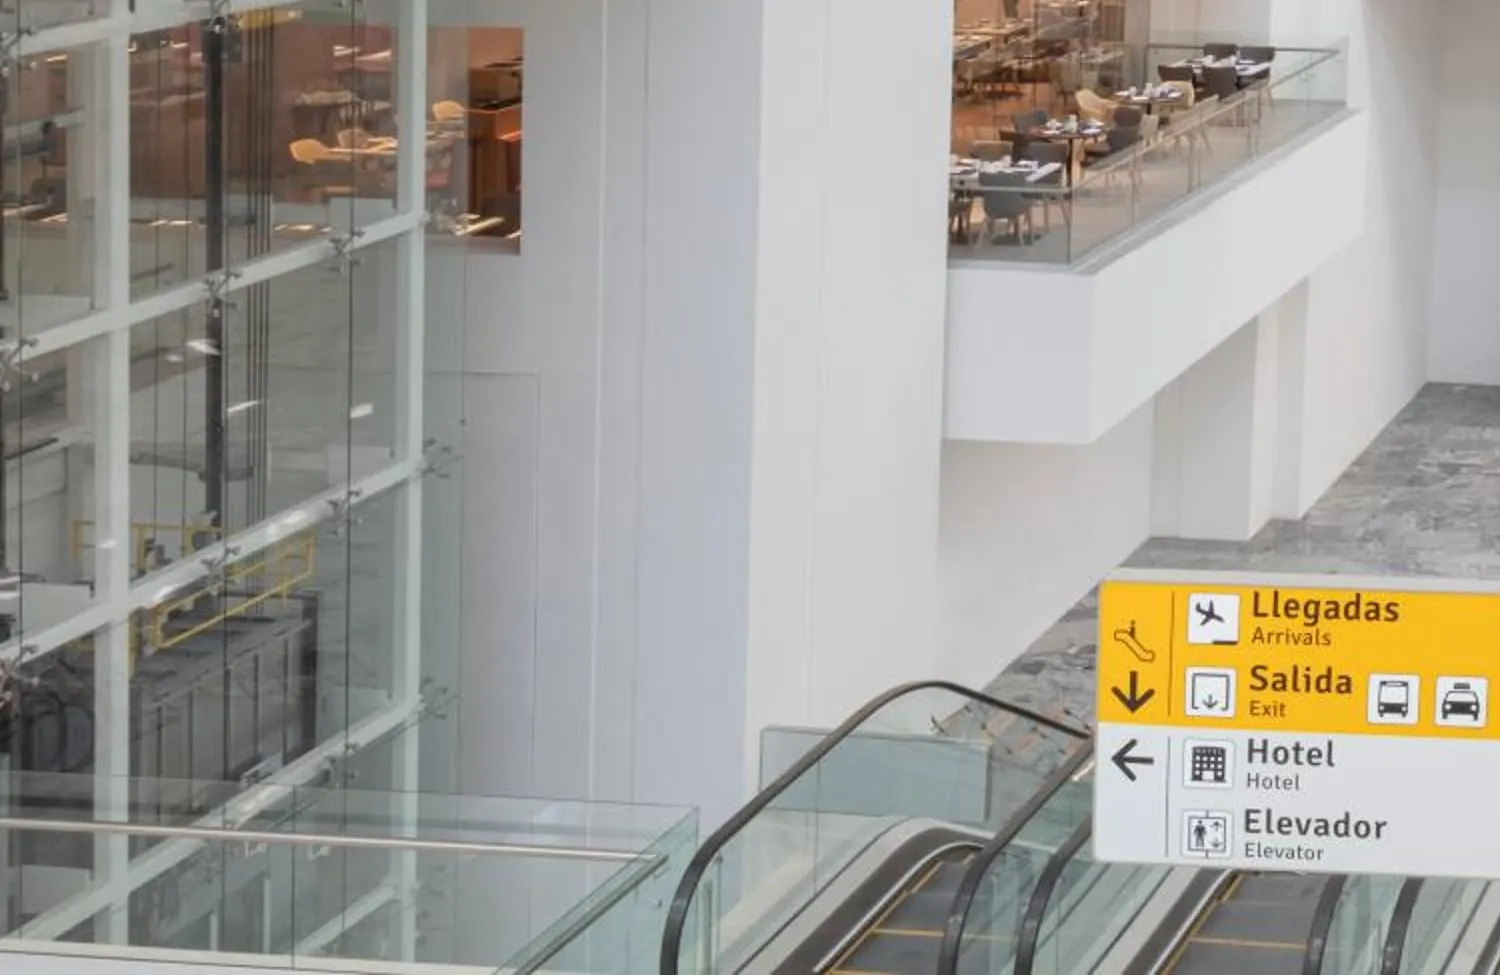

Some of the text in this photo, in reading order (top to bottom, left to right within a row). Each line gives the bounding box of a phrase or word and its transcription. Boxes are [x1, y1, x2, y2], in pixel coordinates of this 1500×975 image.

[1252, 590, 1399, 626] Llegadas
[1251, 627, 1331, 646] Arrivals
[1249, 664, 1352, 695] Salida
[1249, 700, 1286, 717] Exit
[1247, 738, 1335, 768] Hotel
[1246, 772, 1299, 791] Hotel
[1244, 807, 1388, 840] Elevador
[1245, 842, 1324, 862] Elevator
